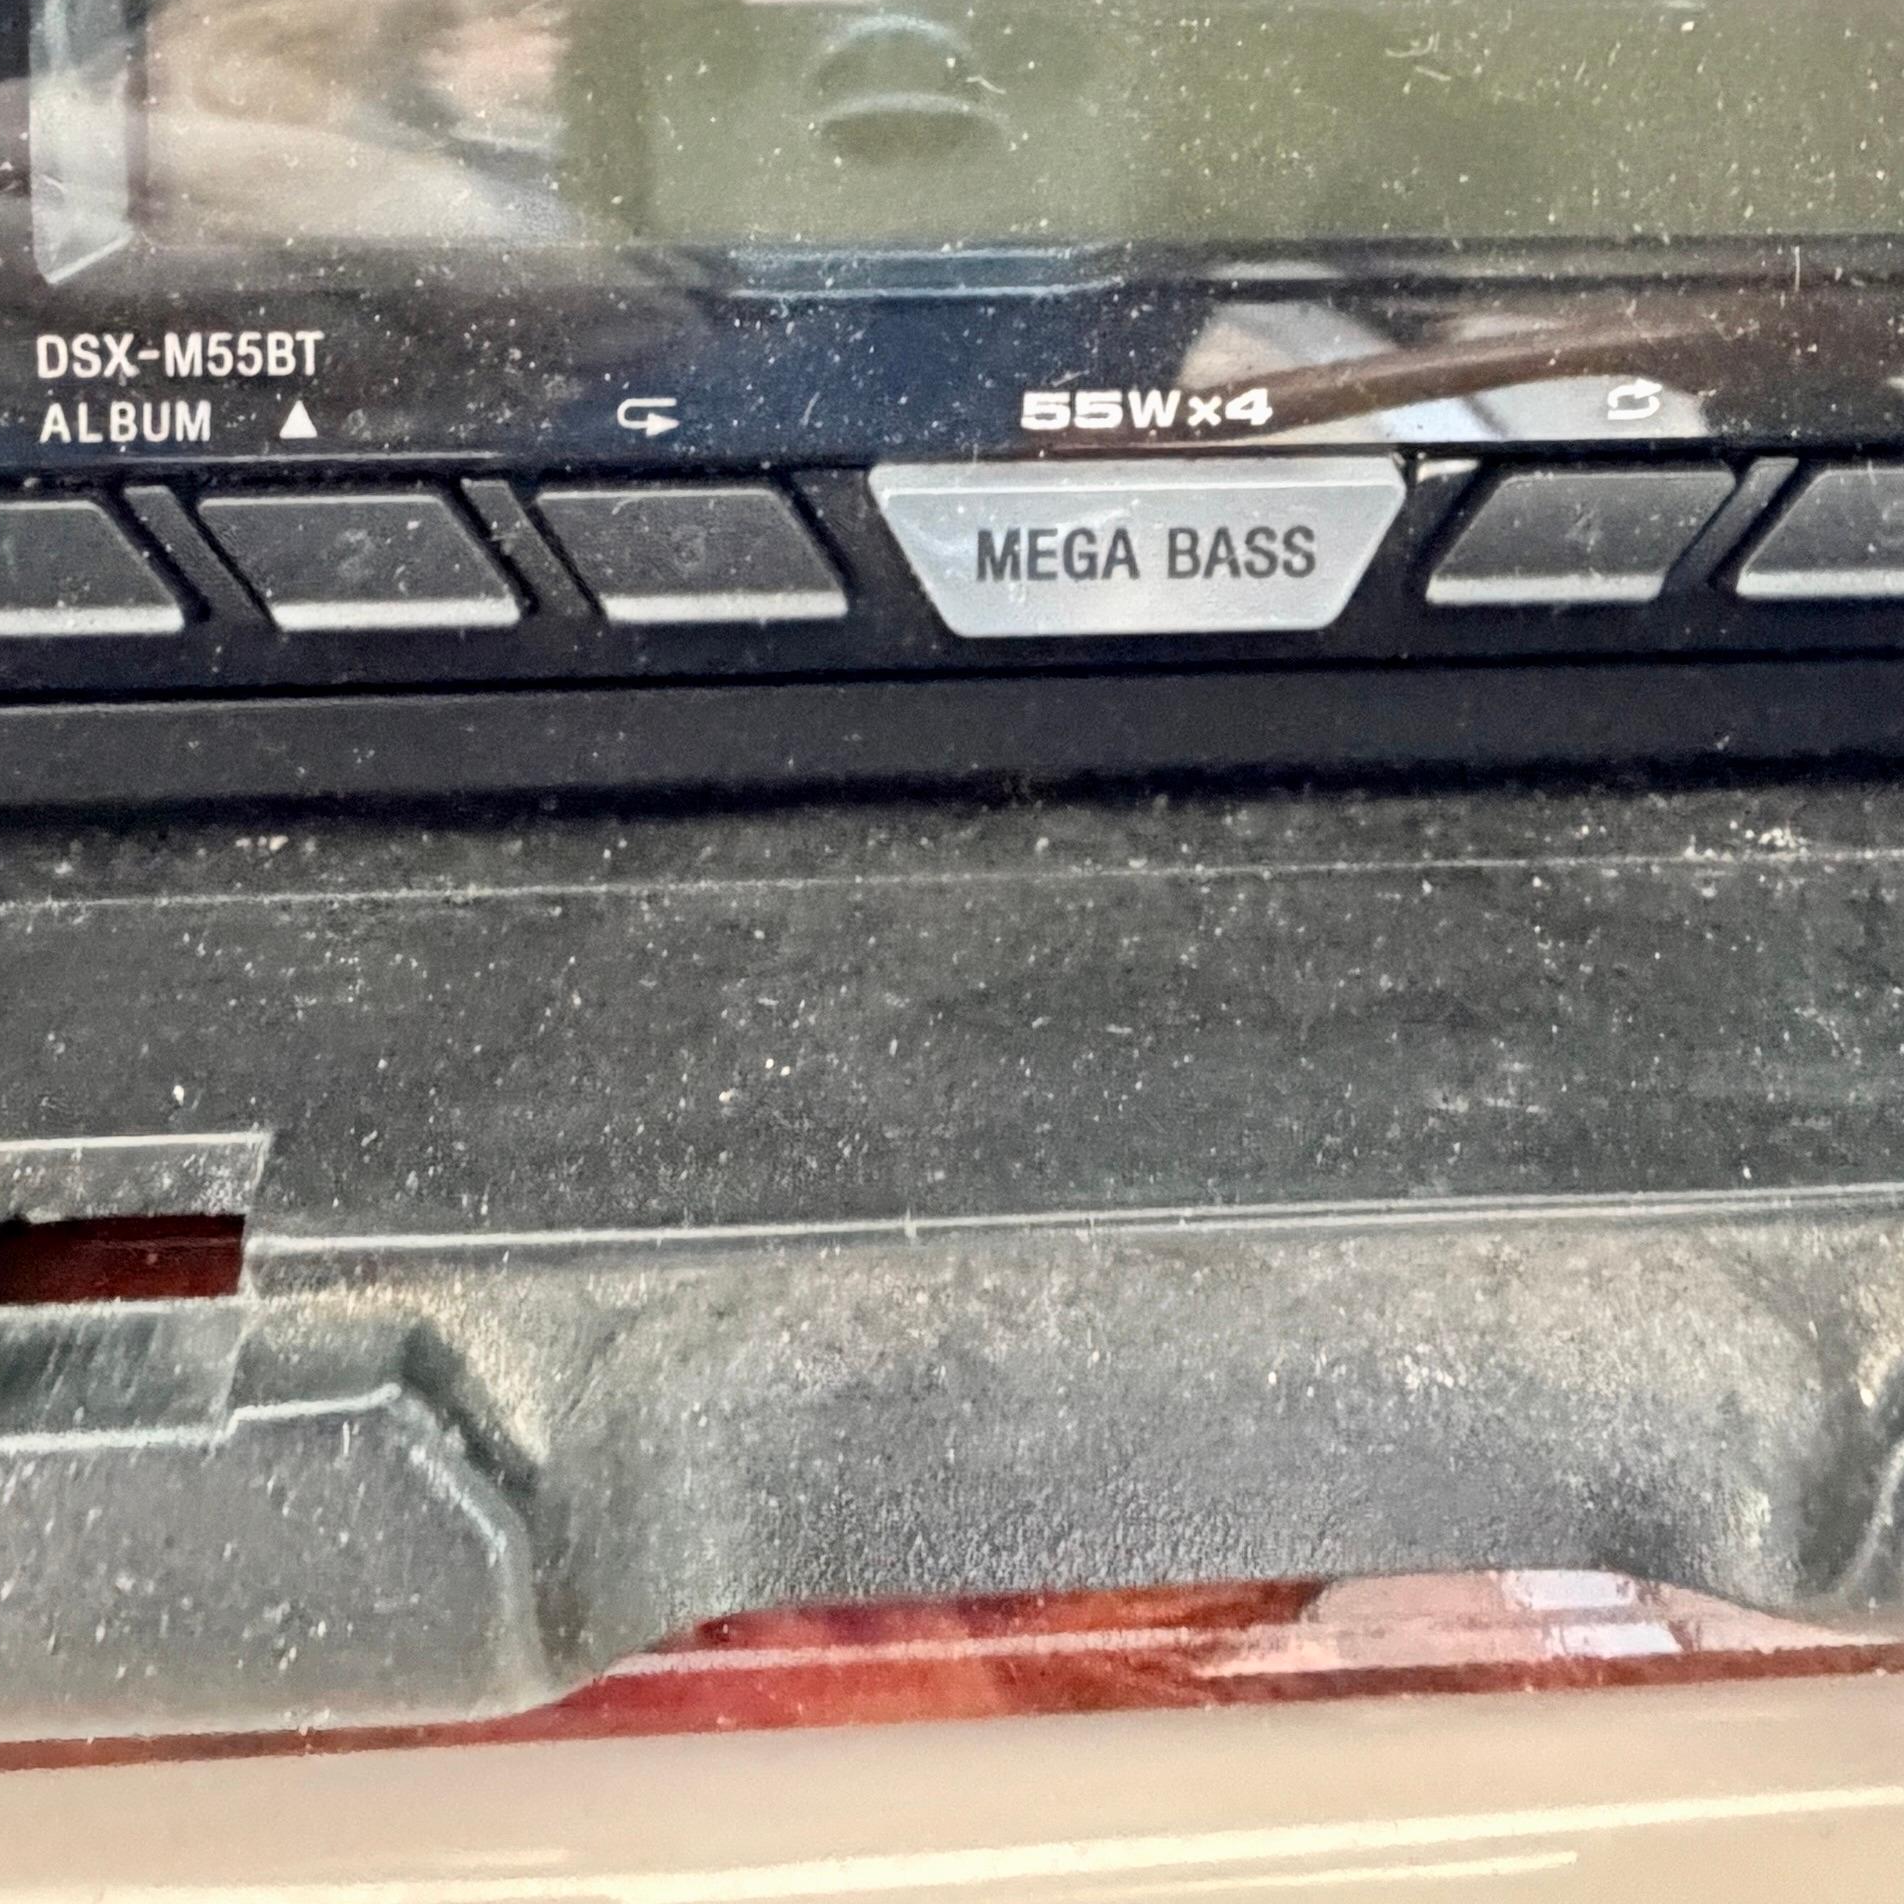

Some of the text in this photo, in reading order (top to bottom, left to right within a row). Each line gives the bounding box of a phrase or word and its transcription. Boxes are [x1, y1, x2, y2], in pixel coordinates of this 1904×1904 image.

[36, 330, 326, 379] DSX-M55BT
[39, 399, 213, 444] ALBUM
[1020, 387, 1274, 431] 55Wx4
[976, 525, 1317, 583] MEGA BASS
